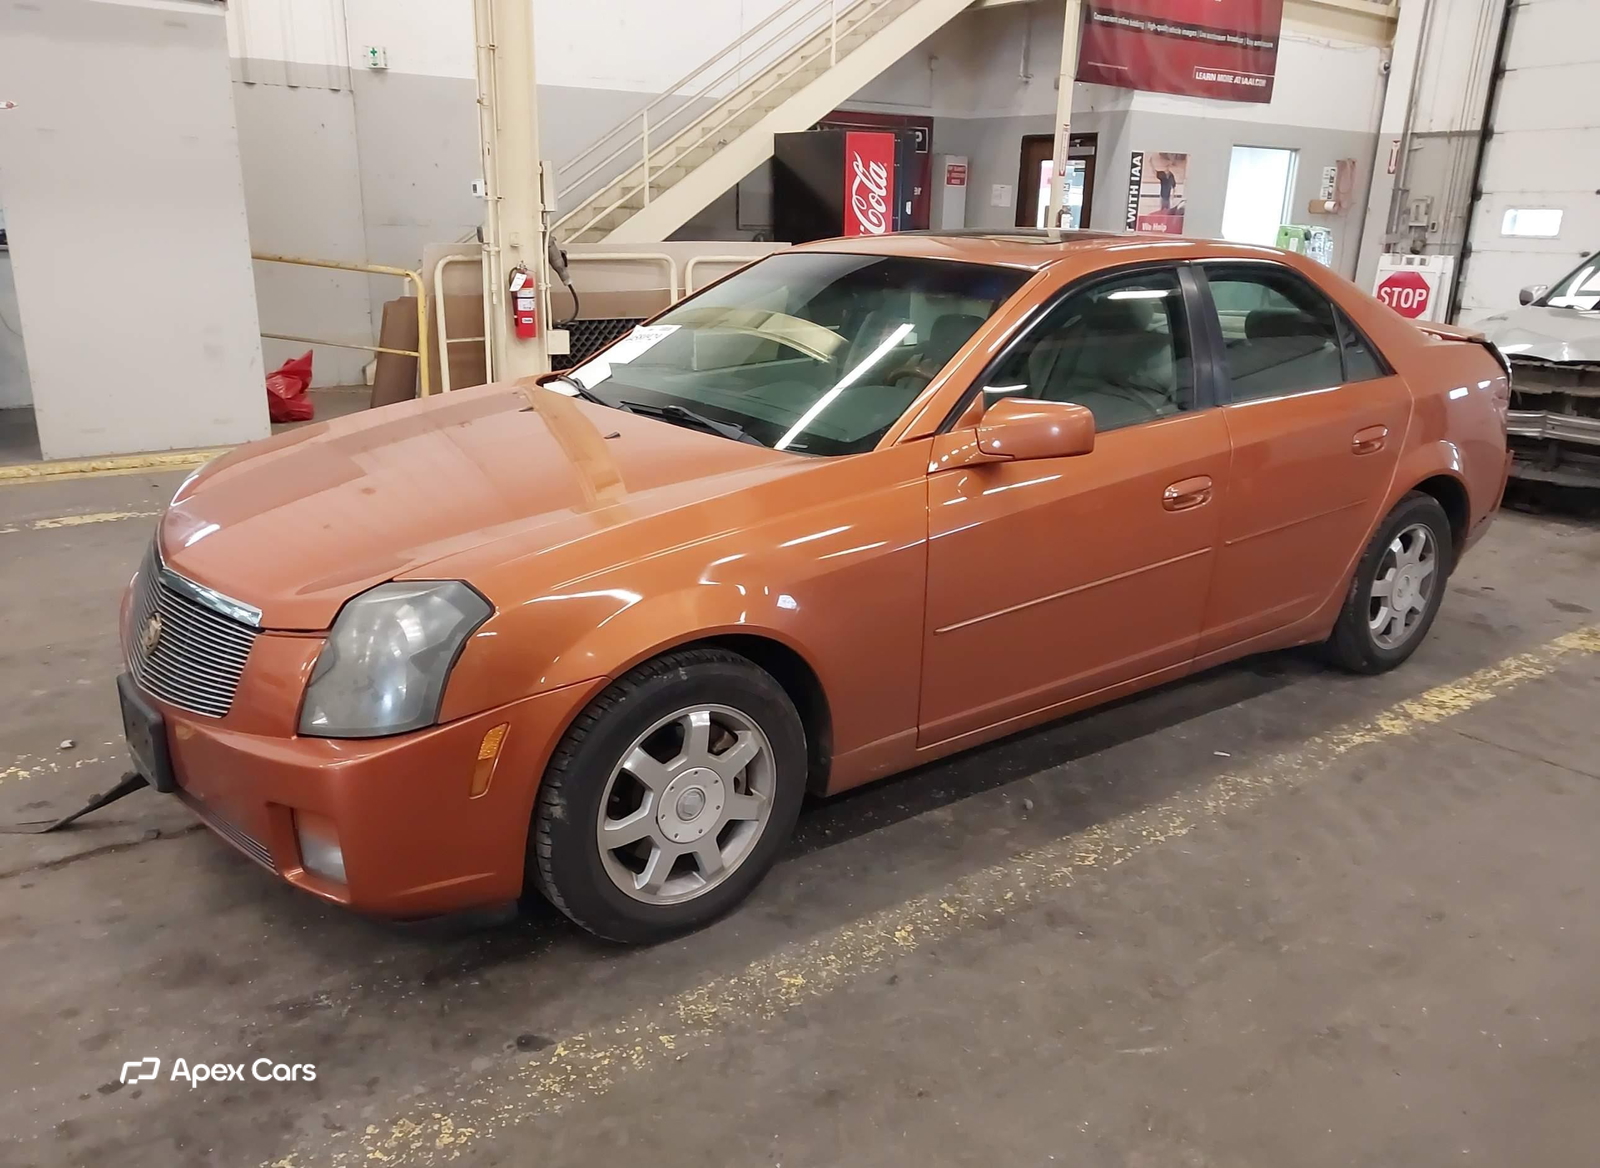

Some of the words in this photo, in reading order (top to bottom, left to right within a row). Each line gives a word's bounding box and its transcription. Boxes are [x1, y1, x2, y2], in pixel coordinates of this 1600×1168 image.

[1195, 71, 1216, 81] LEARN
[1217, 73, 1233, 83] MORE
[1234, 76, 1242, 84] AT
[1130, 155, 1143, 181] IAA
[1126, 185, 1139, 223] WITH
[1152, 223, 1167, 233] Help
[1380, 286, 1427, 309] STOP
